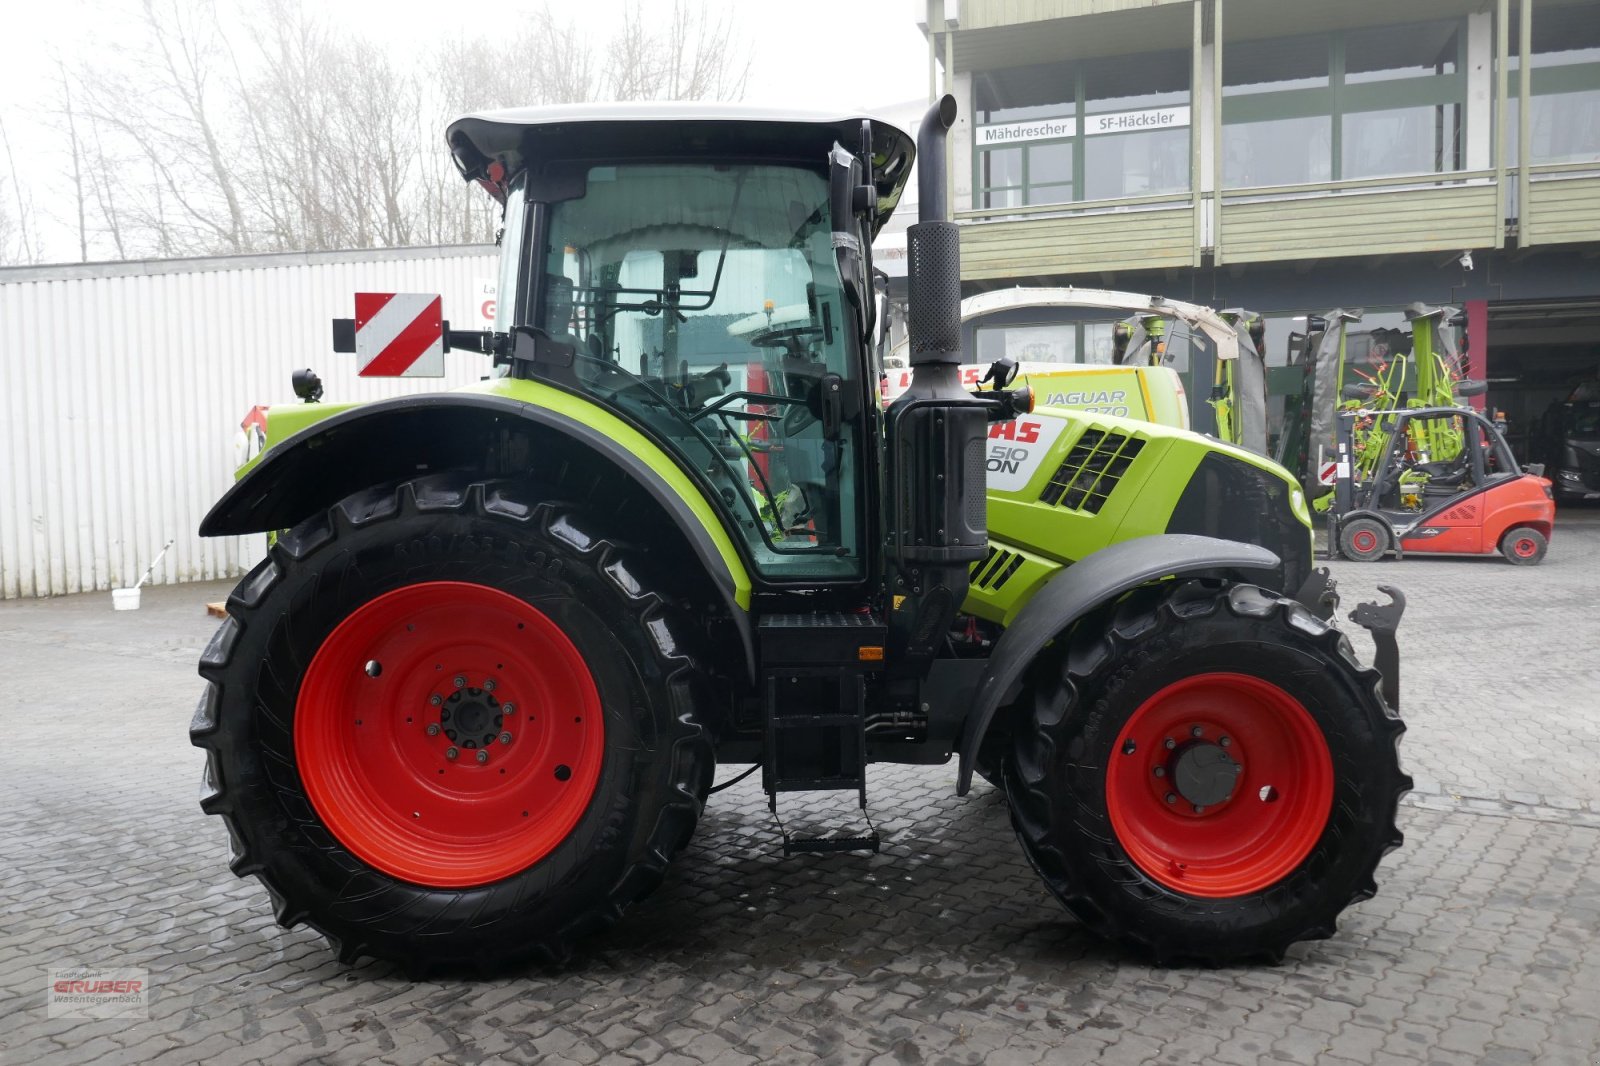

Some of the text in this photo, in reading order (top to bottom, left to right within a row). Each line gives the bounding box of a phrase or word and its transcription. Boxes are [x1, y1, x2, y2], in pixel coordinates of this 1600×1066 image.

[1099, 112, 1175, 130] SF-Häcksler
[985, 123, 1068, 141] Mähdrescher
[1045, 391, 1126, 405] JAGUAR
[989, 446, 1029, 462] 510
